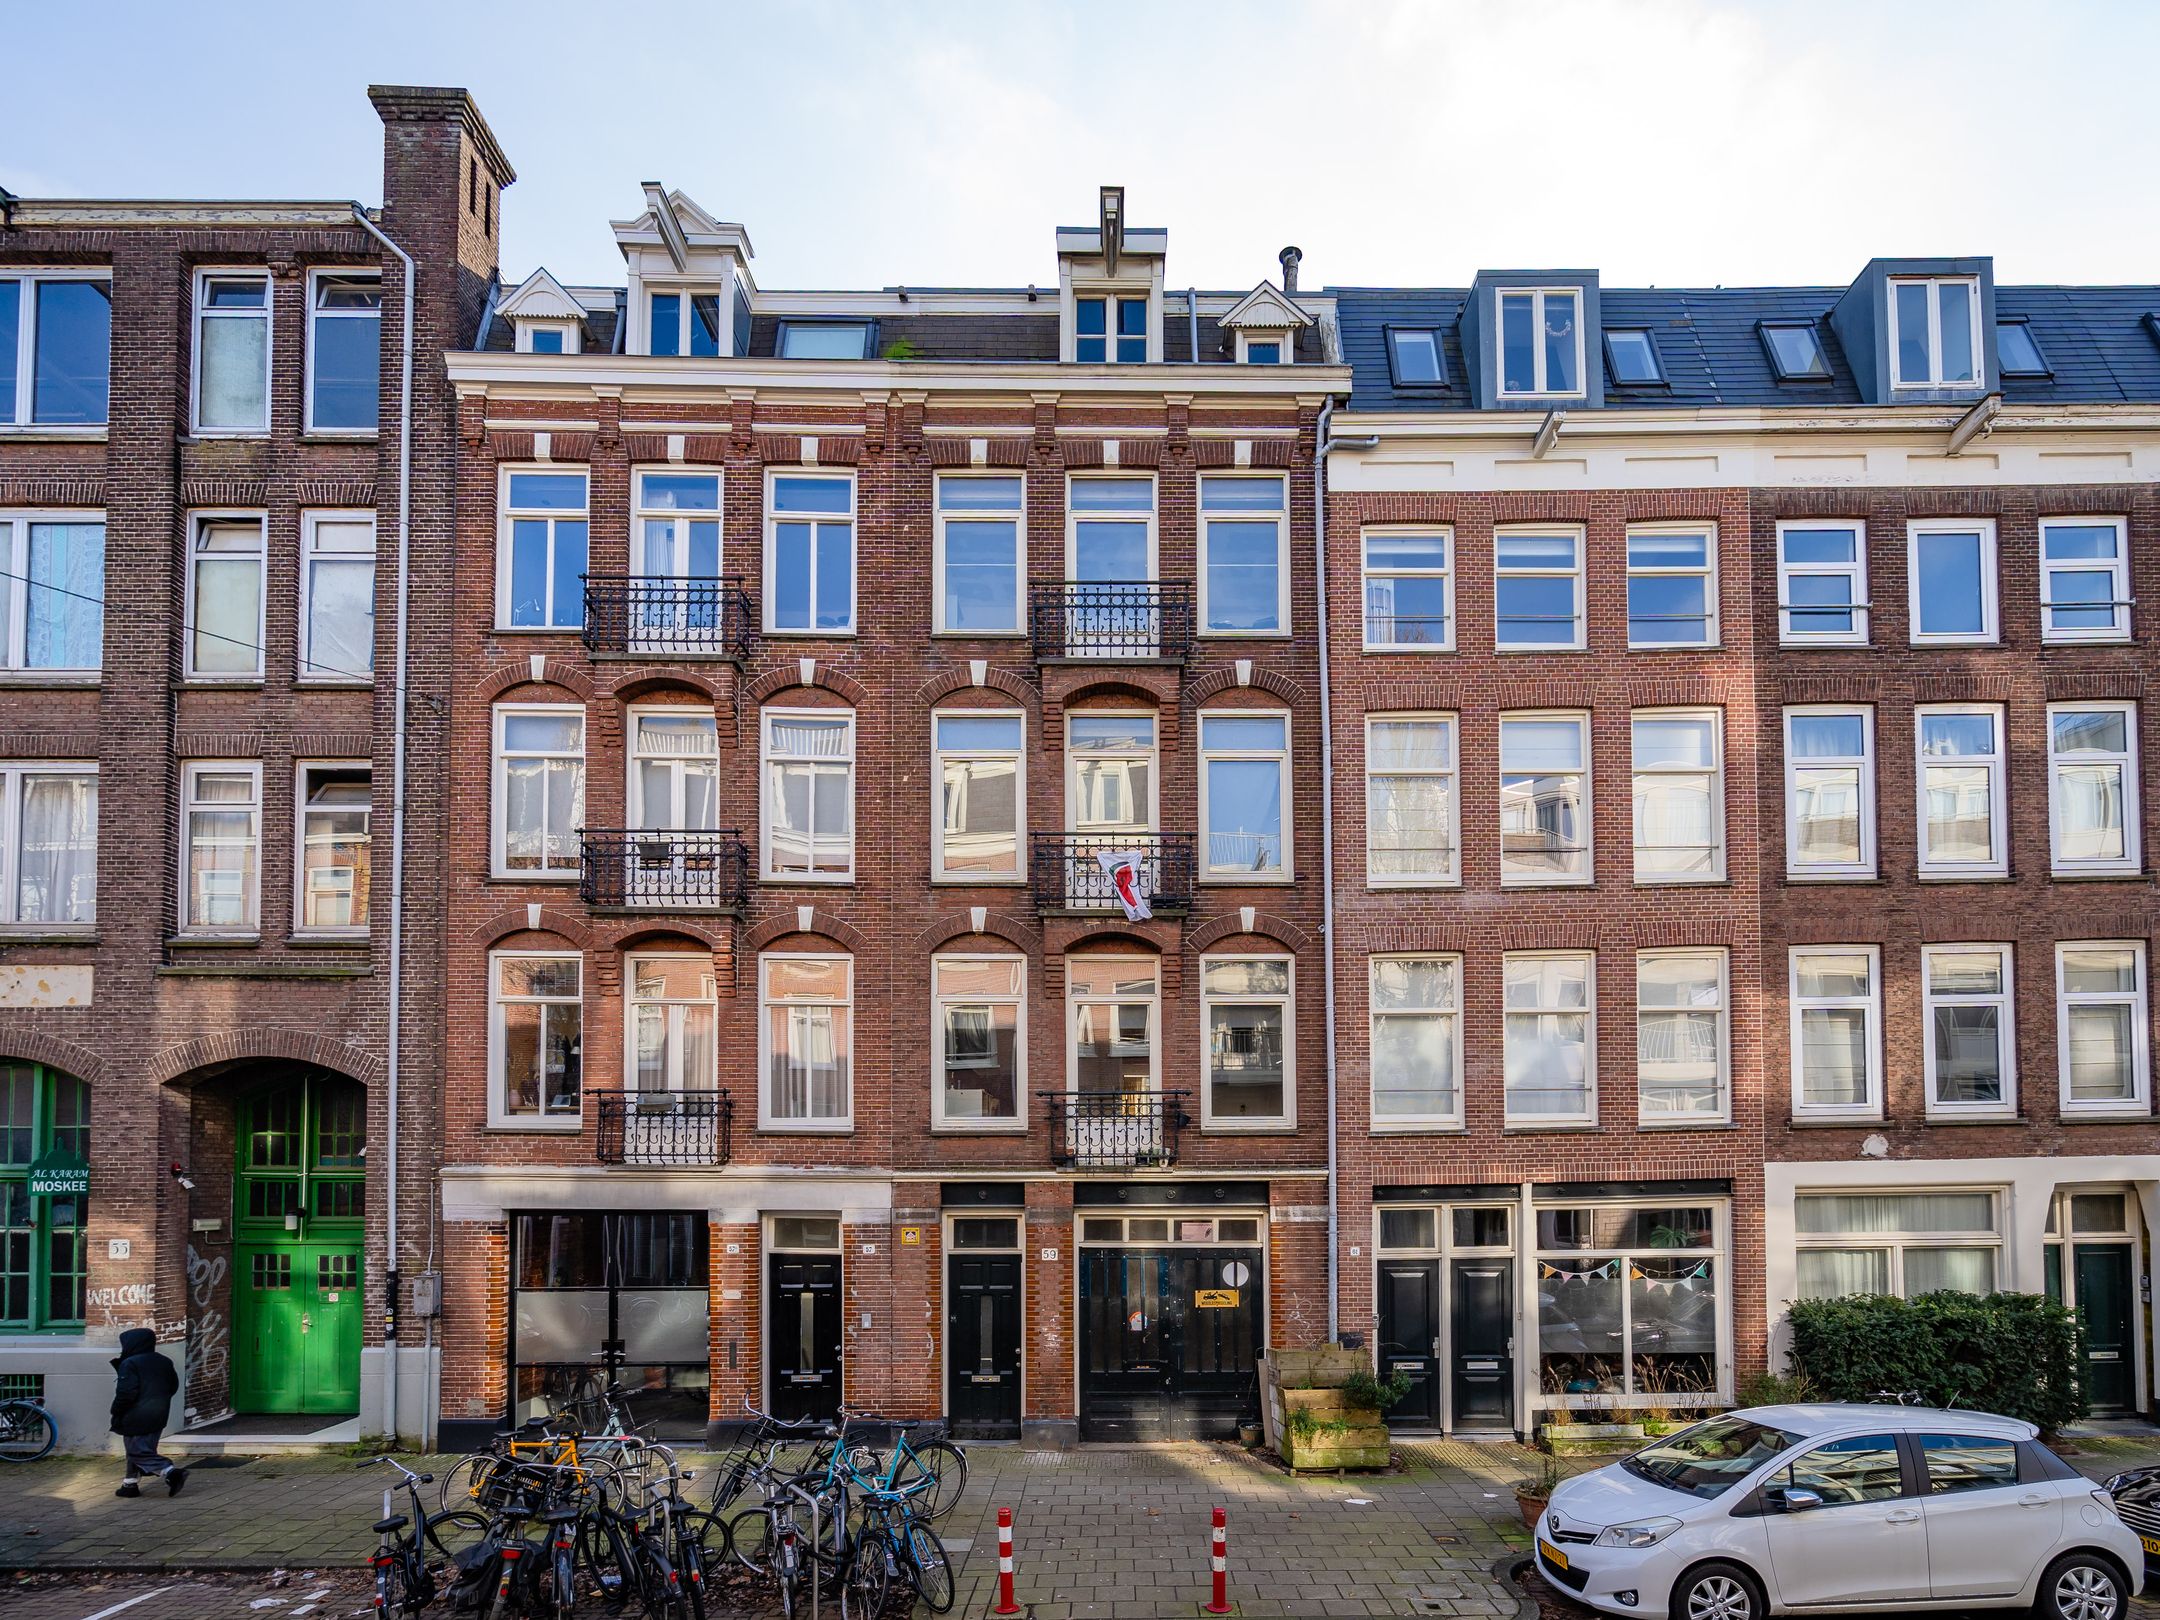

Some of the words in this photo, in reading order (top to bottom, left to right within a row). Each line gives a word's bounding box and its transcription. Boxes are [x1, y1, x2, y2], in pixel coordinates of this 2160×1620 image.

[31, 1169, 48, 1179] AL
[49, 1169, 89, 1179] KARAM
[32, 1180, 87, 1192] MOSKEE
[112, 1242, 128, 1255] 55
[1043, 1249, 1057, 1260] 59
